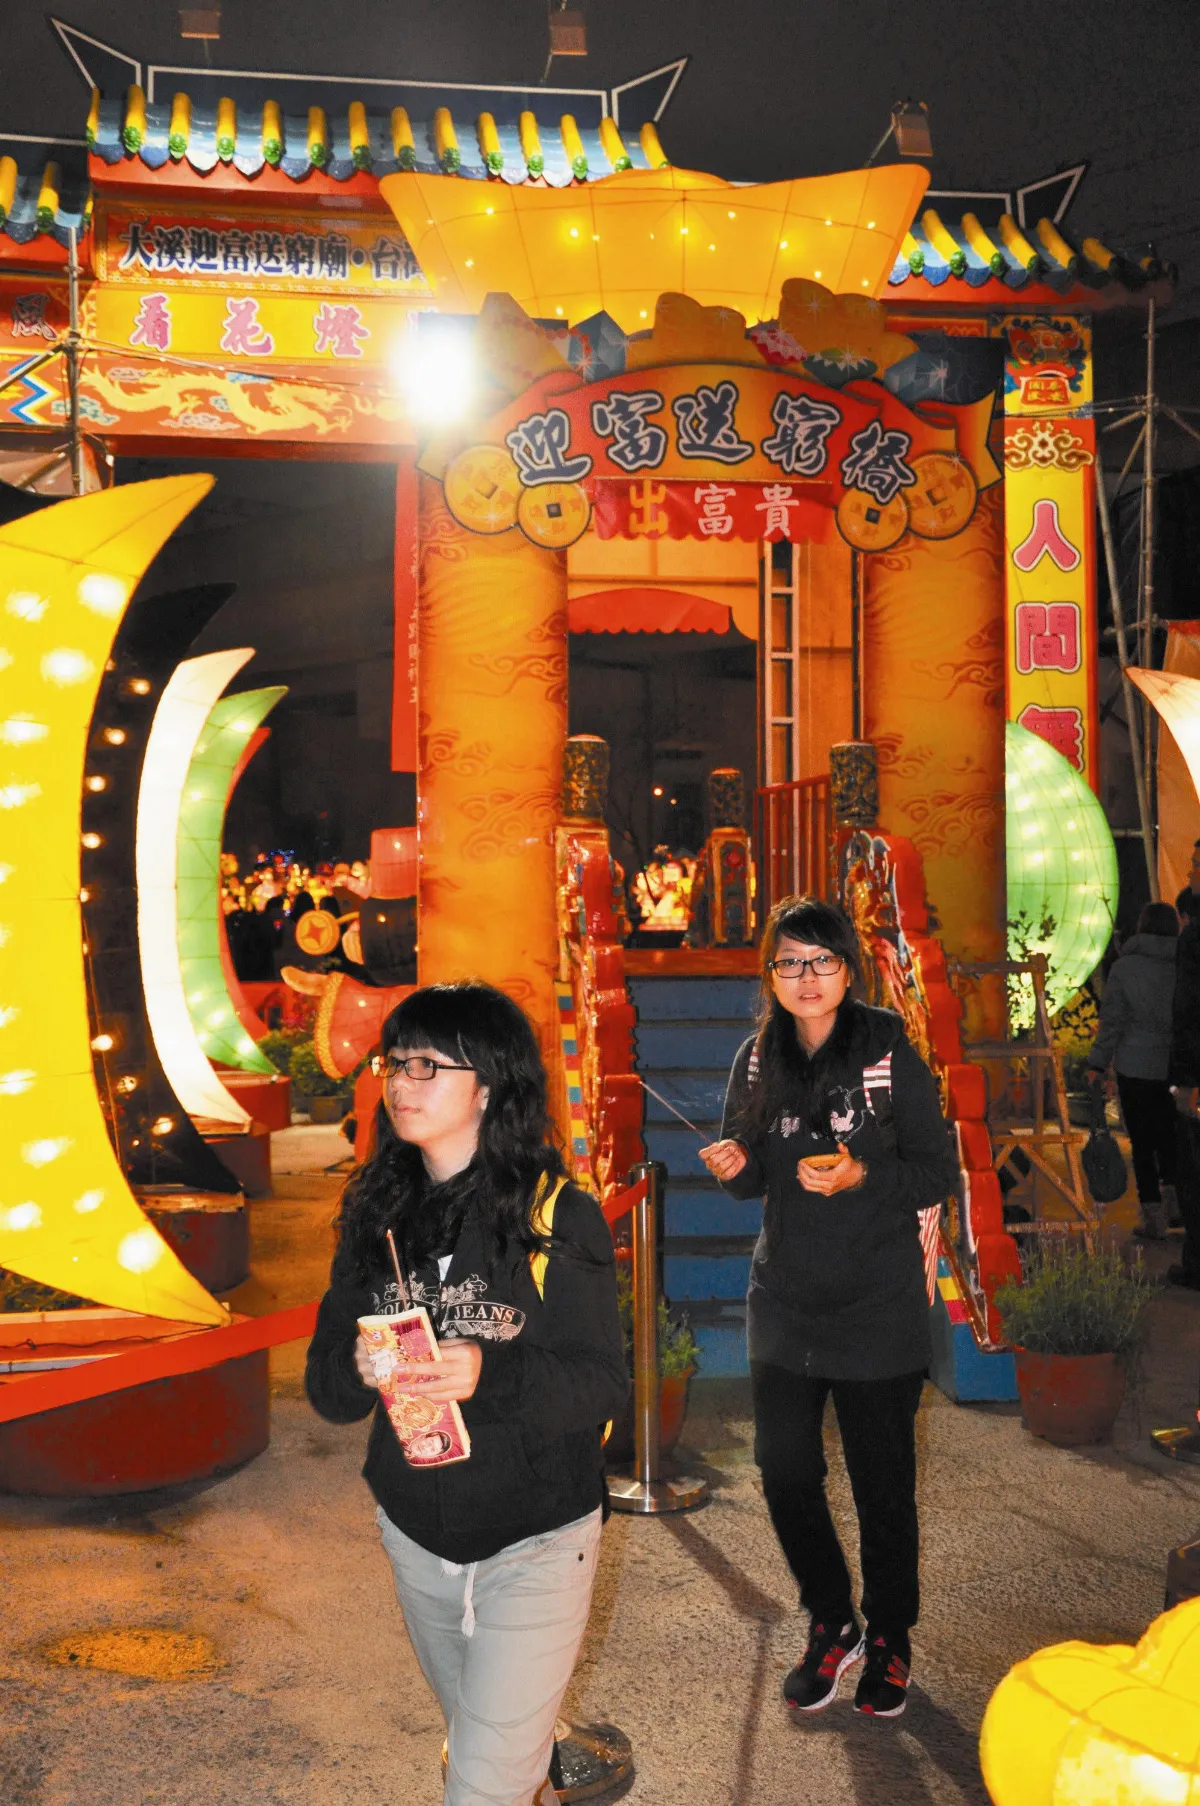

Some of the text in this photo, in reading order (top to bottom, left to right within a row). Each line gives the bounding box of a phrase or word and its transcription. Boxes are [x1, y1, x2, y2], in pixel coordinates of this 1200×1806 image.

[129, 292, 437, 357] 看花燈
[505, 380, 918, 505] 迎富送窮橋
[629, 480, 800, 537] 出富貴
[454, 1304, 516, 1323] JEANS
